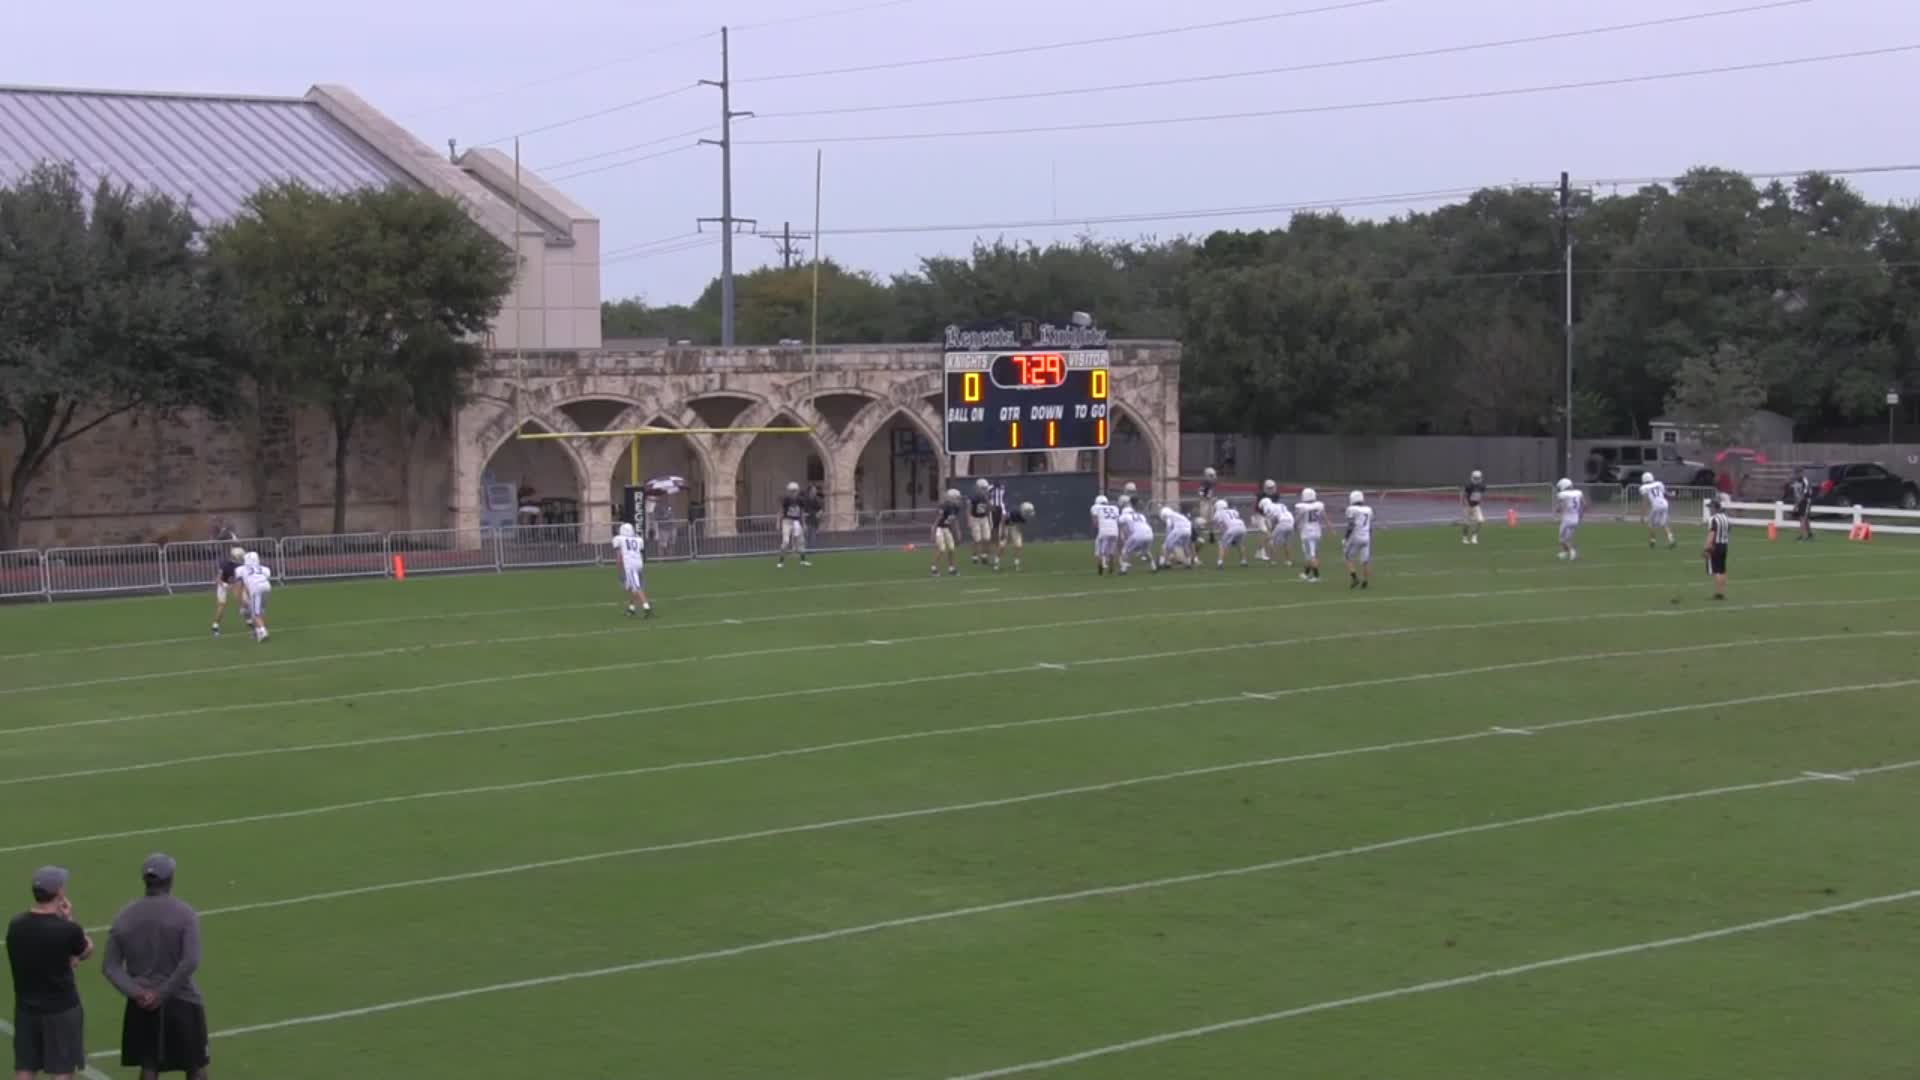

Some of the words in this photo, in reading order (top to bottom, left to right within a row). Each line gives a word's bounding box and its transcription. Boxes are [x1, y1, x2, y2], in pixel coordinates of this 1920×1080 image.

[1012, 355, 1061, 385] 7:29
[964, 372, 980, 402] 0
[1092, 369, 1107, 399] 0
[949, 407, 968, 422] BALL
[971, 407, 985, 422] ON
[1000, 406, 1021, 421] QTR
[1031, 405, 1064, 420] DOWN
[1075, 404, 1088, 418] TO
[1091, 404, 1106, 418] GO
[625, 538, 639, 551] 10
